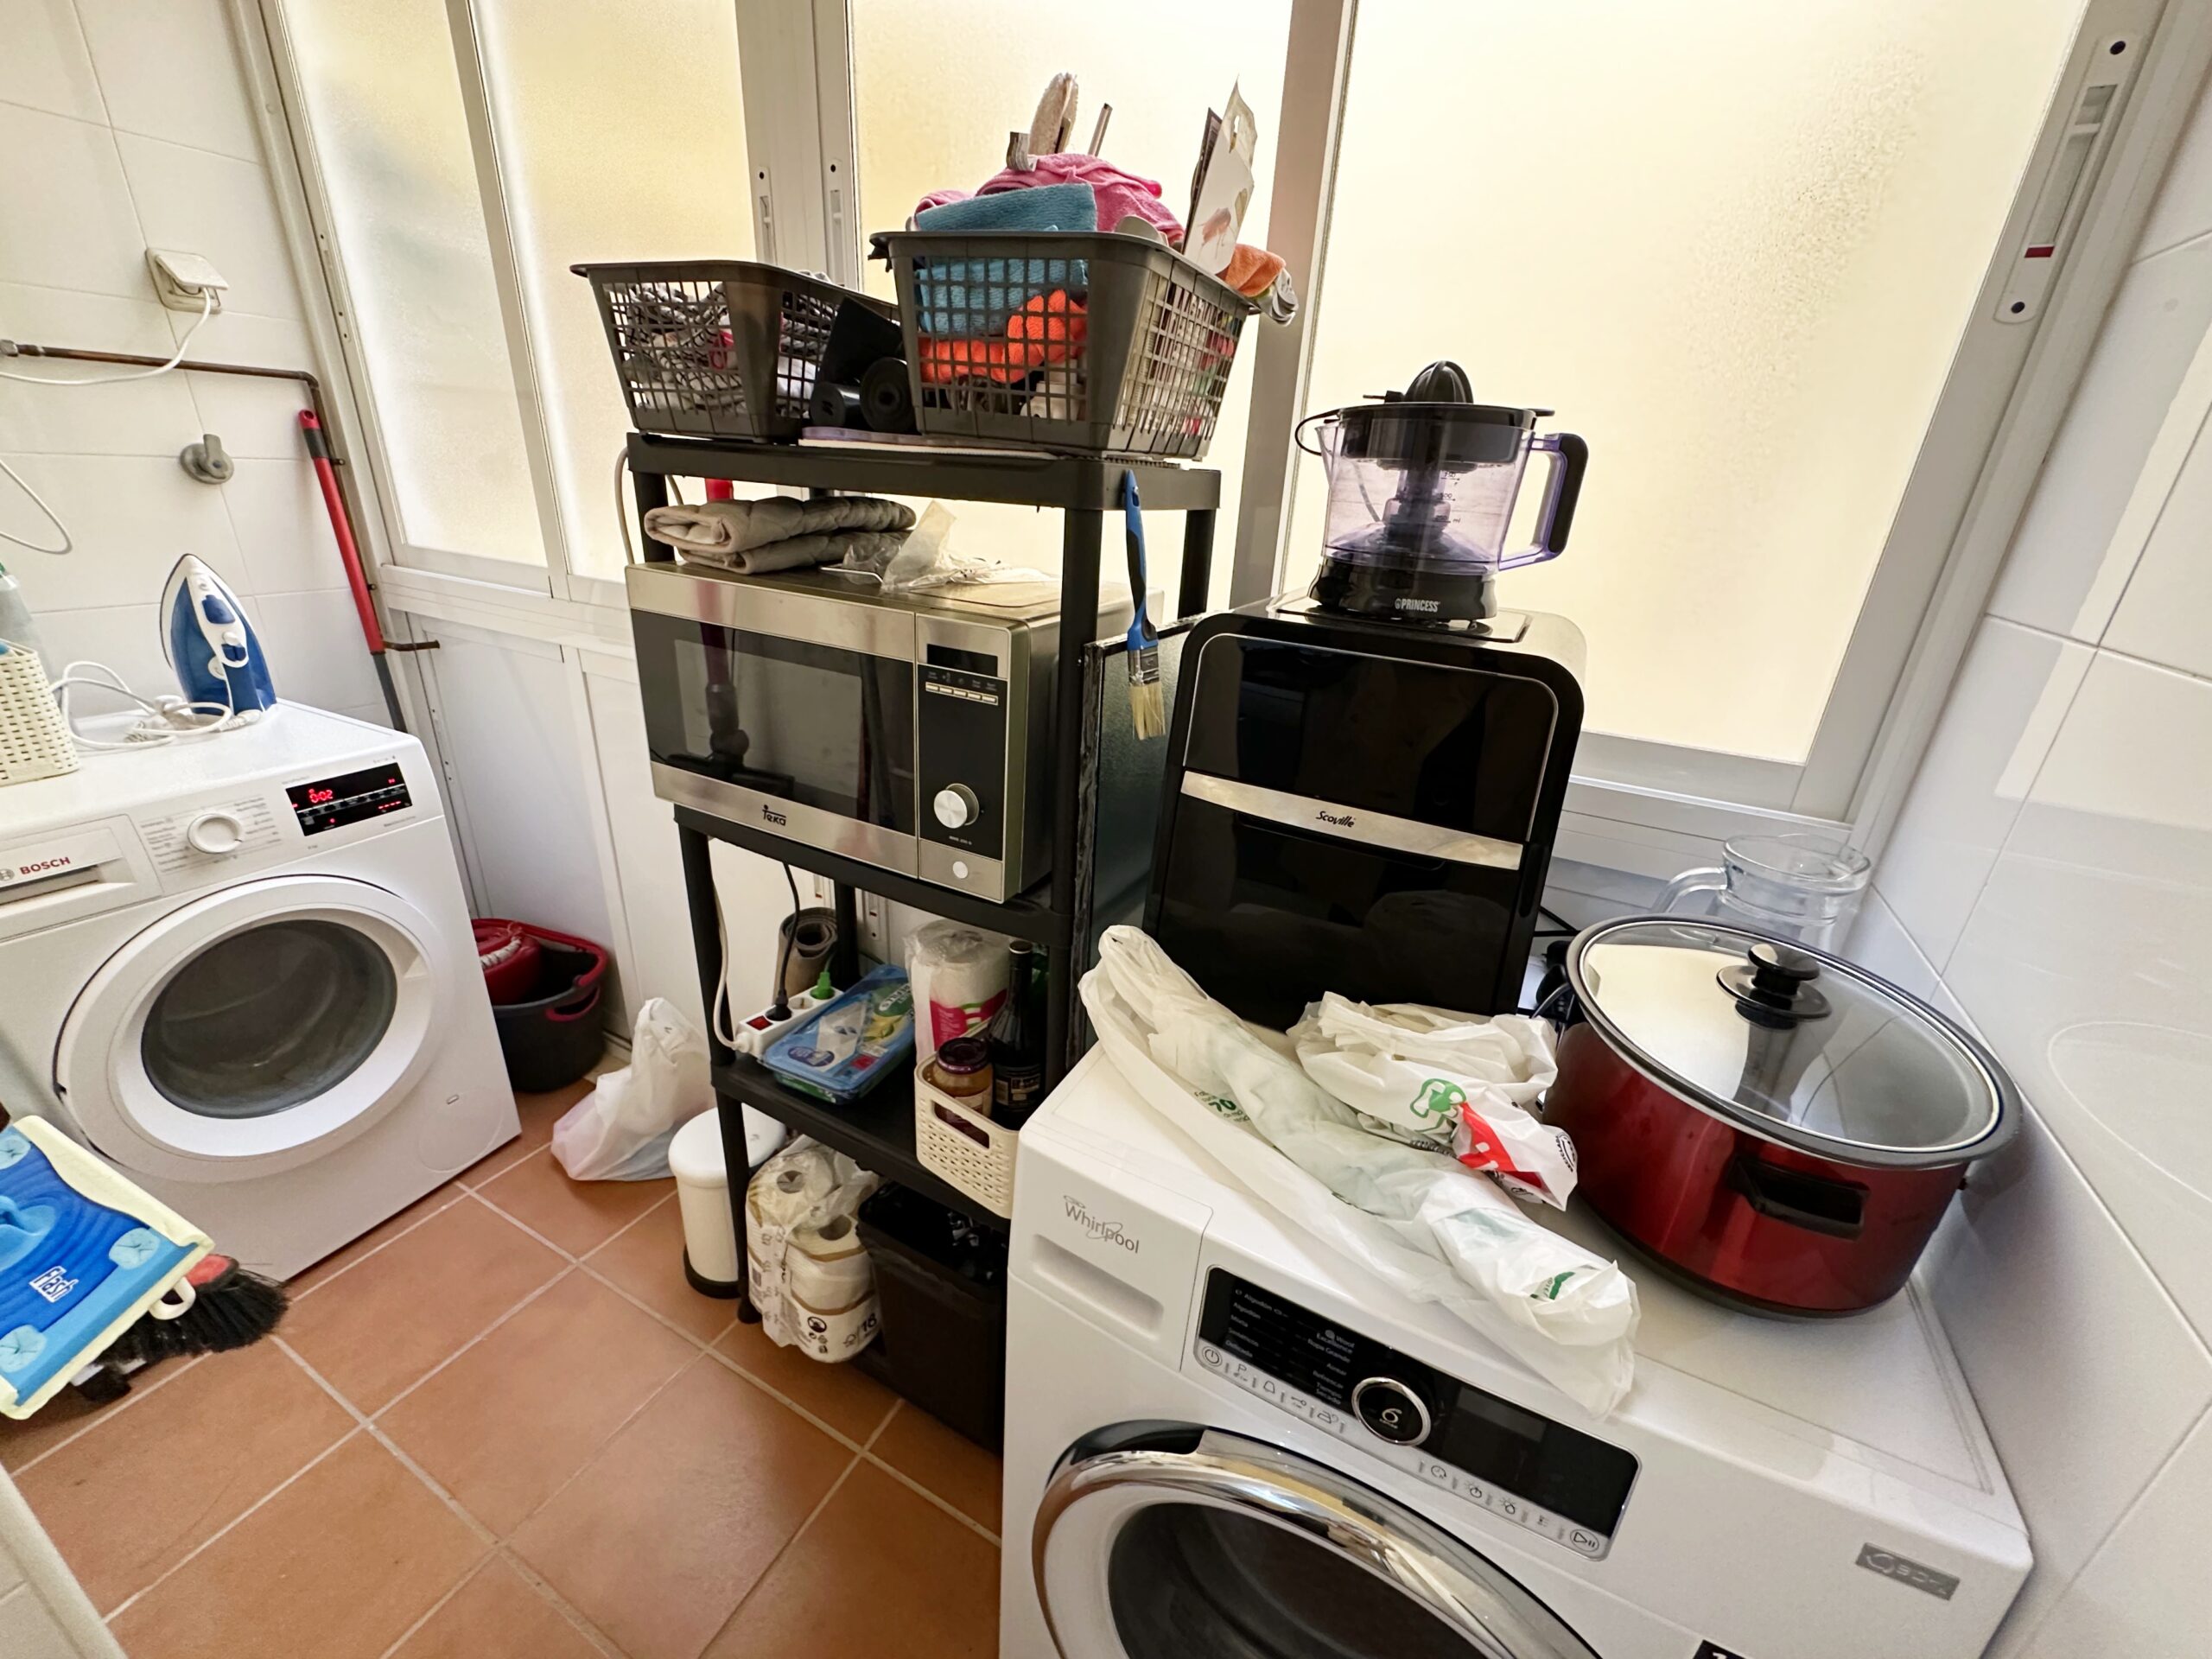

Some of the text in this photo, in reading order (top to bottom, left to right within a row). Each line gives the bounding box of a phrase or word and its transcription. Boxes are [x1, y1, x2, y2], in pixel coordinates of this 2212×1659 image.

[1400, 598, 1439, 613] PRINCESS
[1315, 810, 1355, 828] Scoville
[19, 856, 71, 874] BOSCH
[1064, 1199, 1140, 1254] Whirlpool
[33, 1267, 76, 1300] Flash
